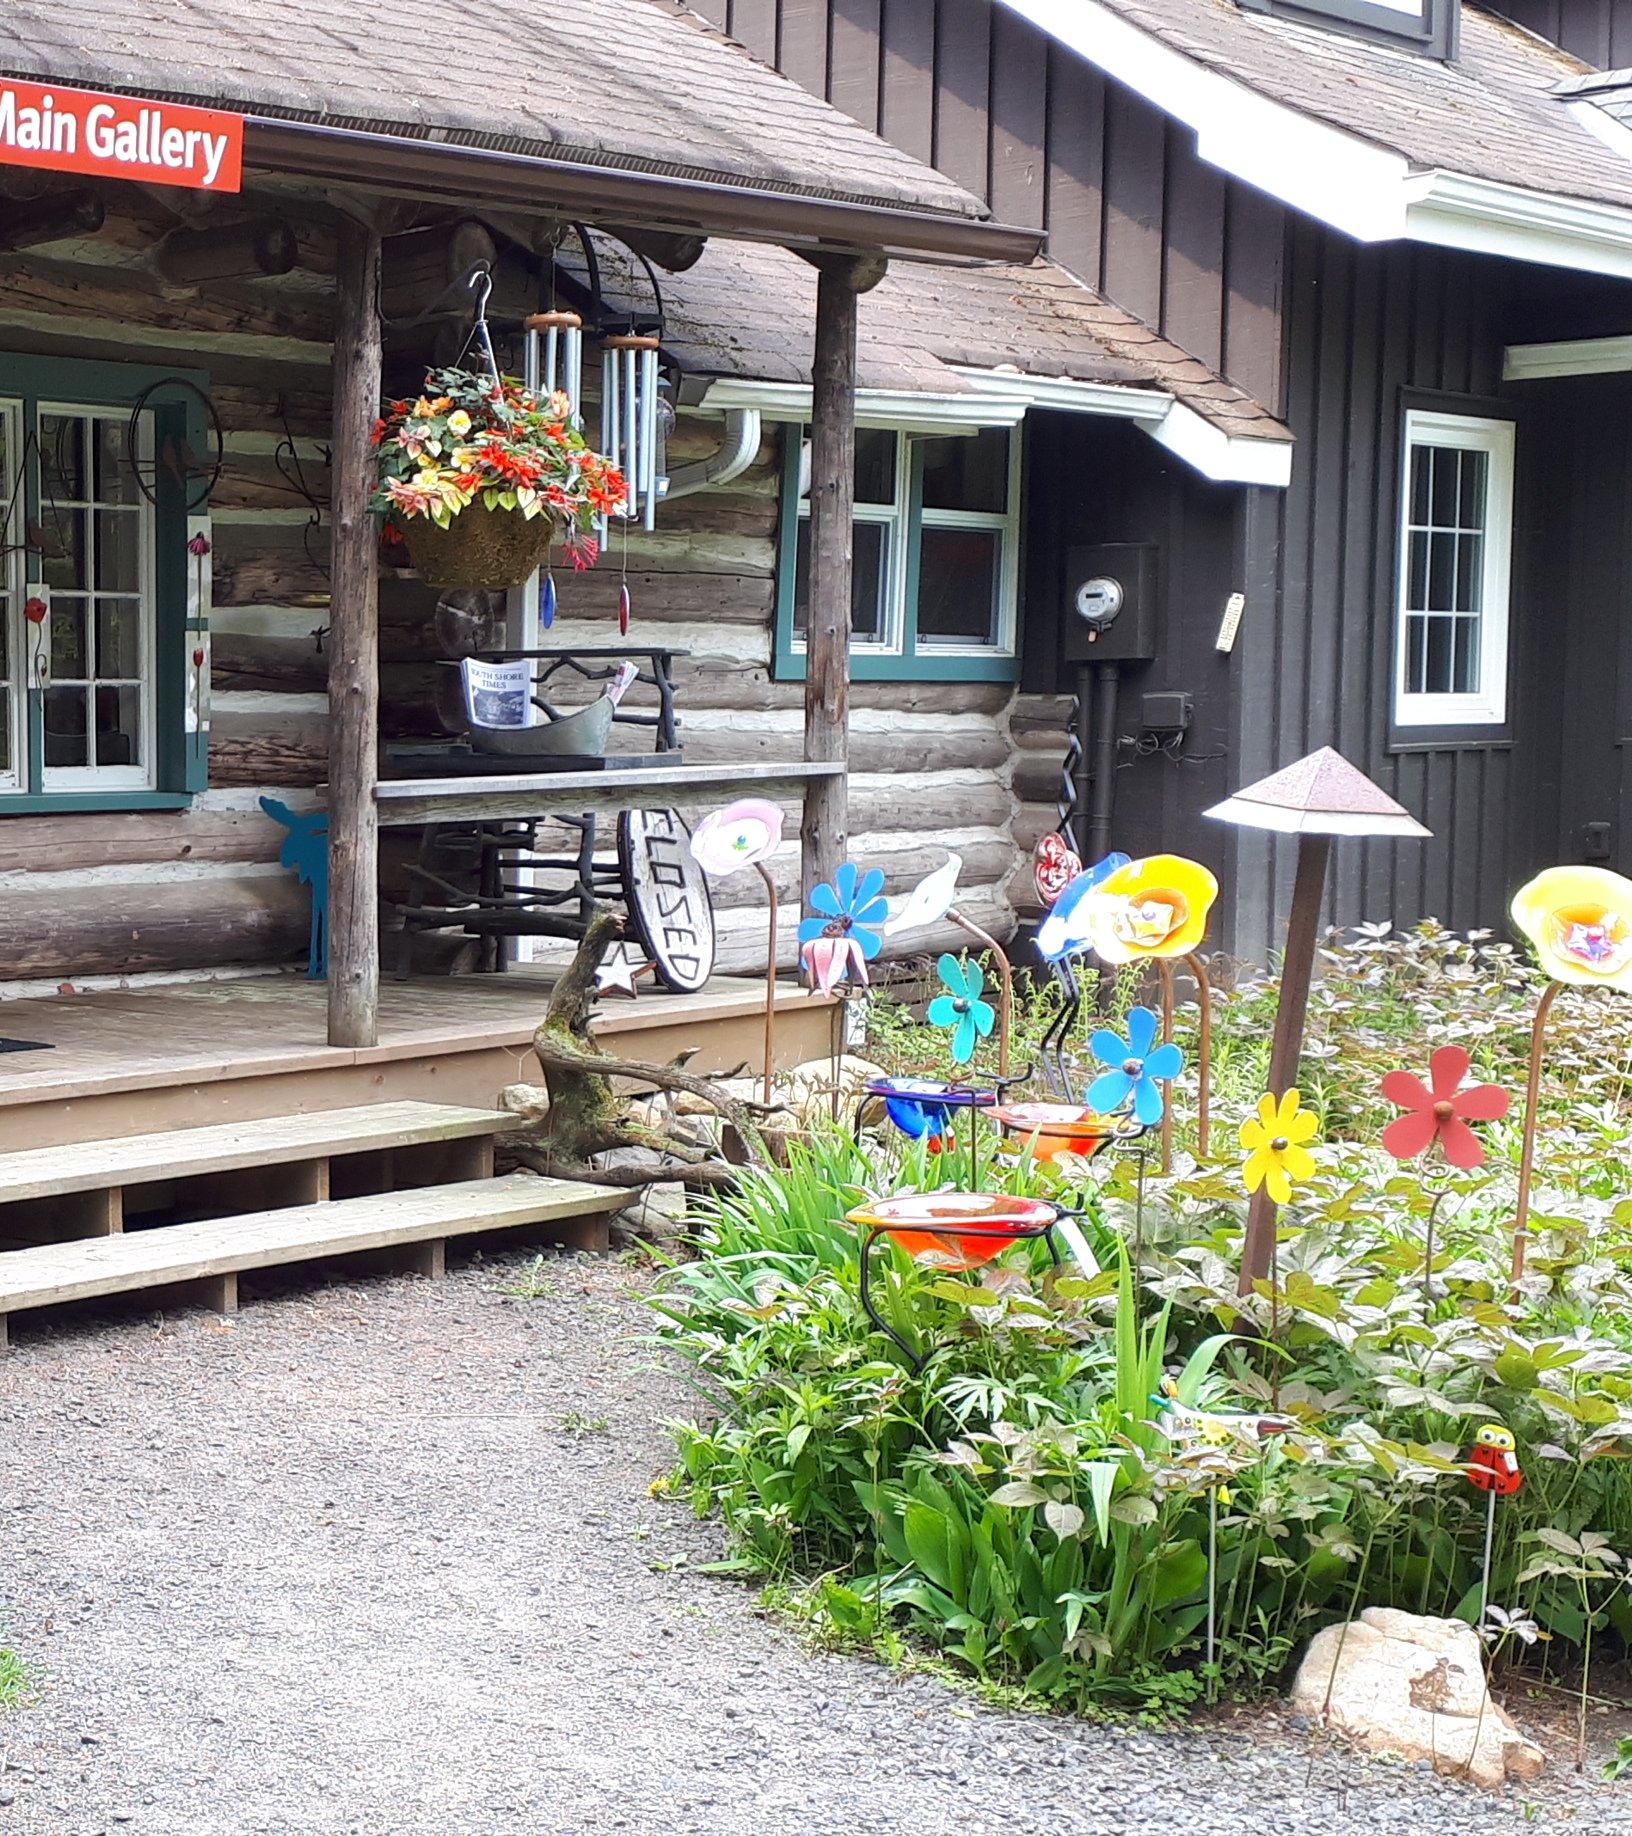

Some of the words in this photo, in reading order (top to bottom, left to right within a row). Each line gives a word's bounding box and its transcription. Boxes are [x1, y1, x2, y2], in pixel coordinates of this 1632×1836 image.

[85, 103, 228, 185] Gallery
[482, 679, 507, 689] TIMES
[494, 671, 524, 681] SHORE
[641, 807, 701, 982] CLOSED
